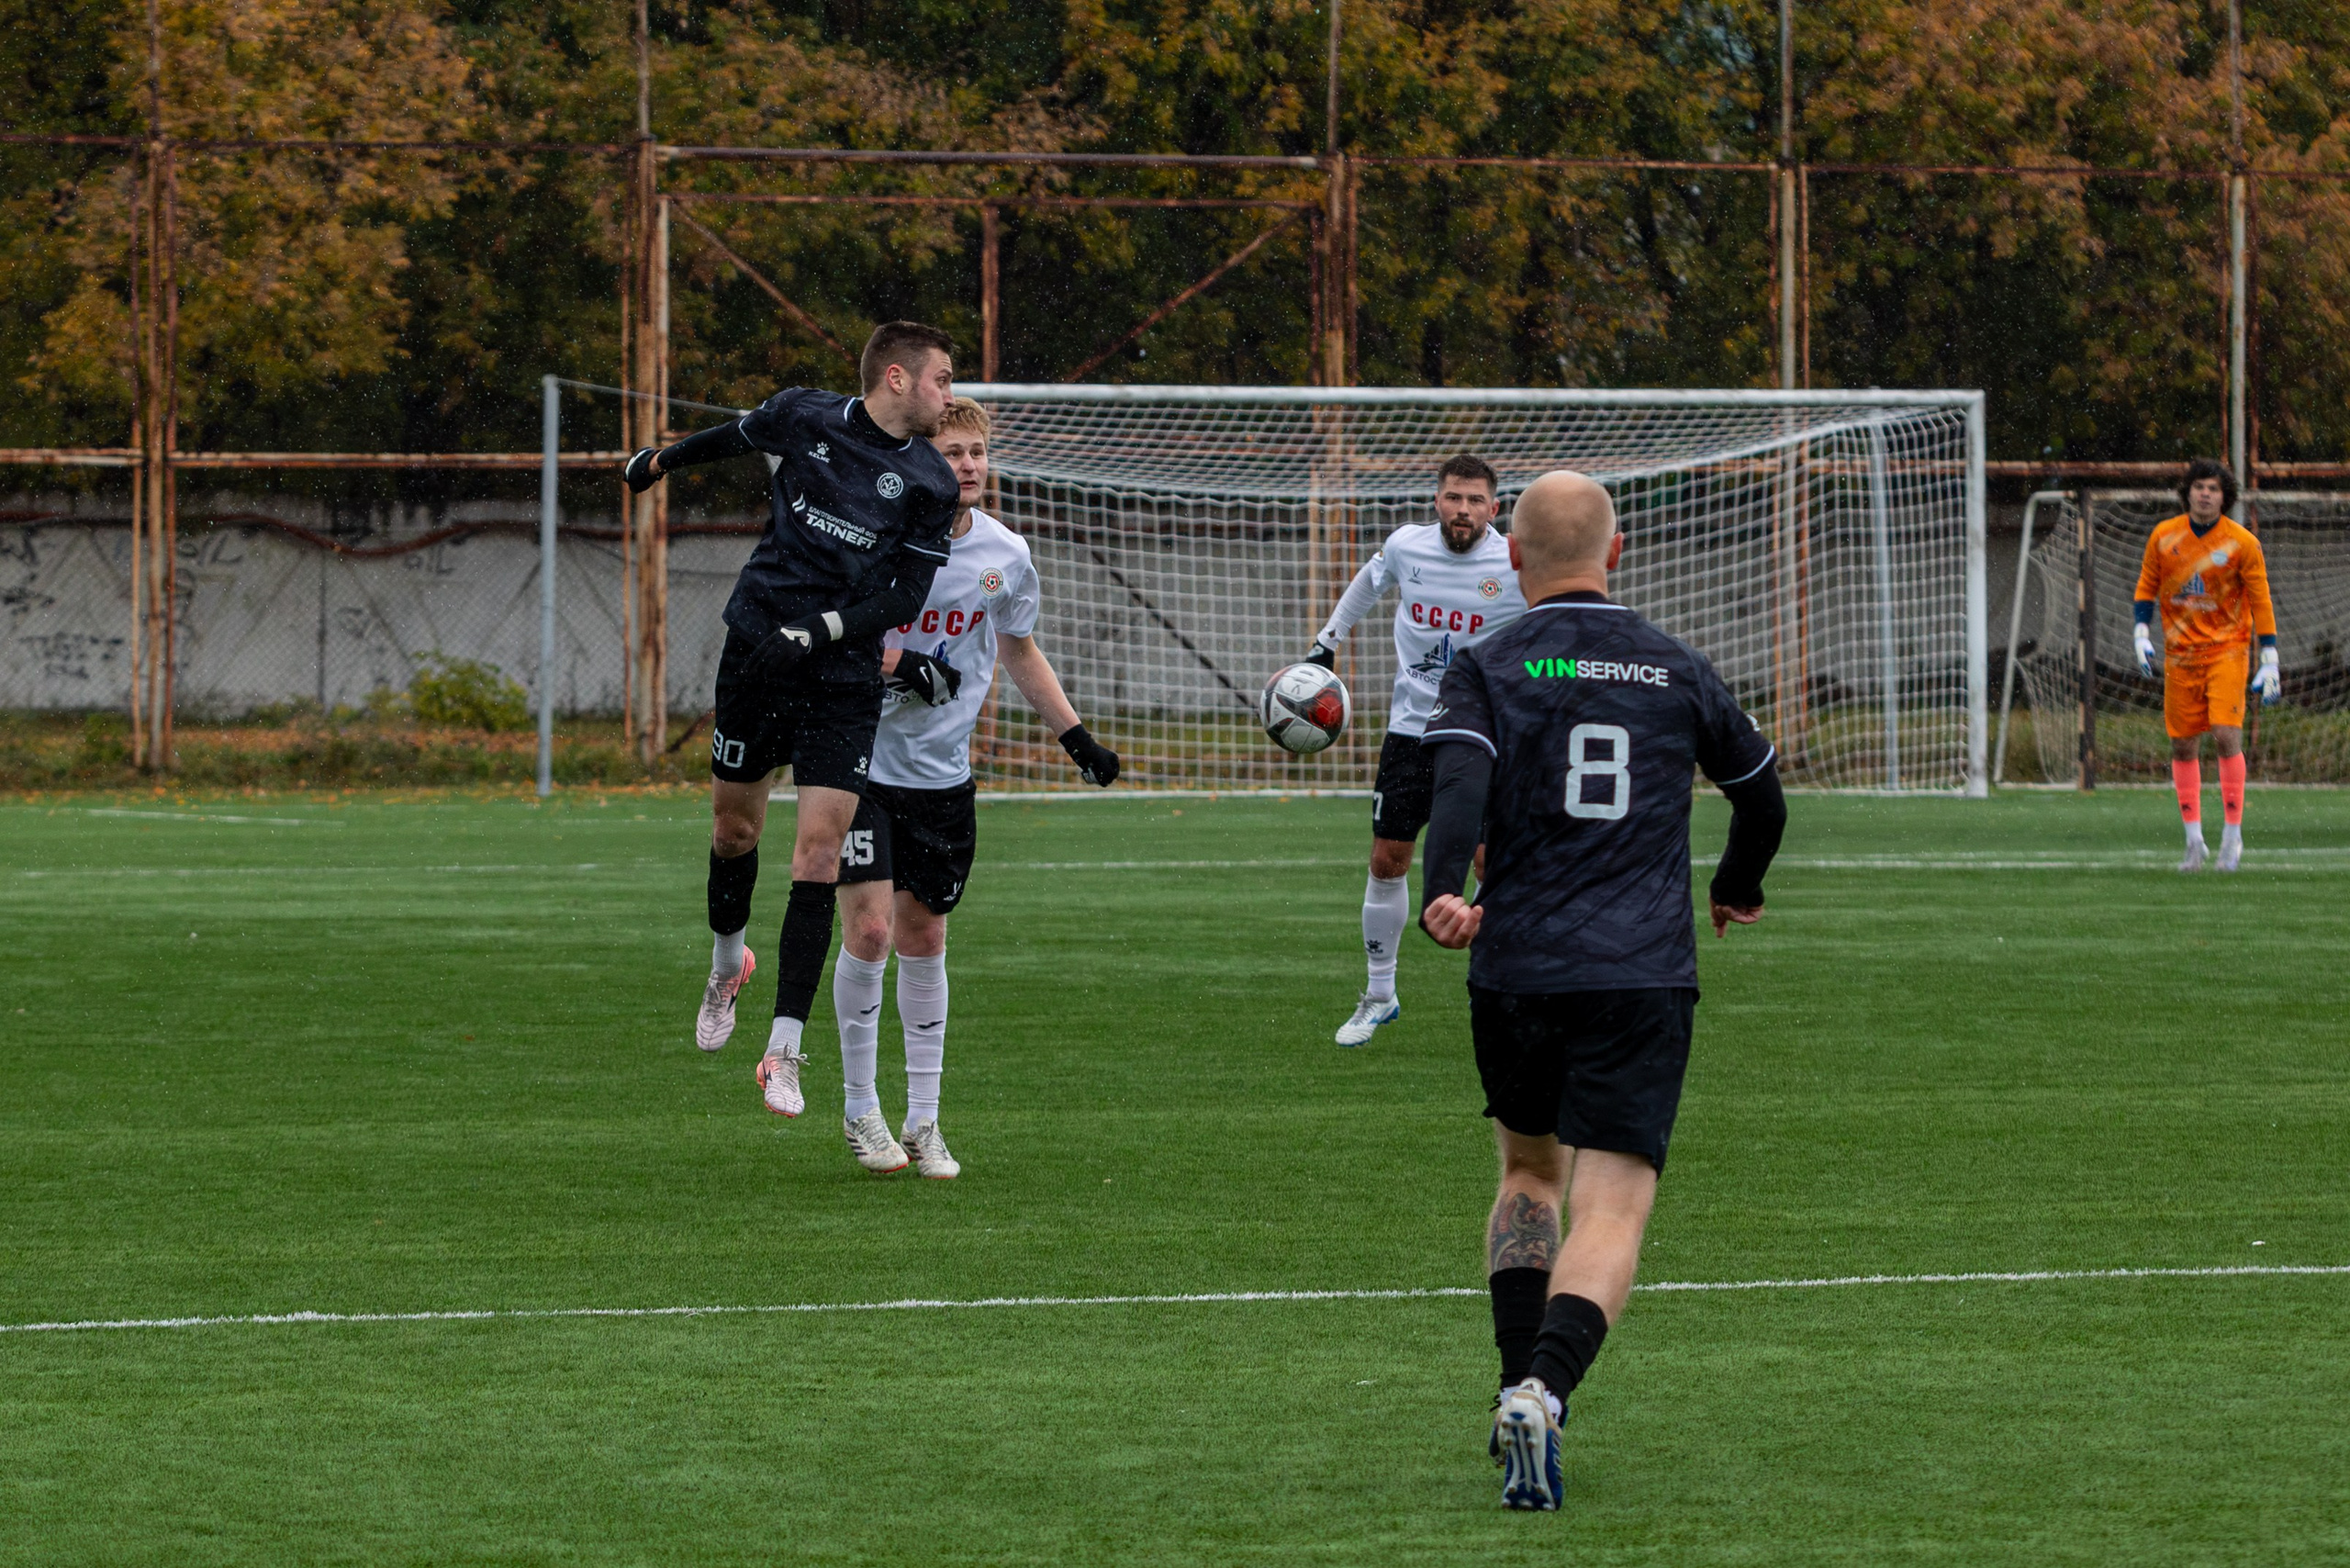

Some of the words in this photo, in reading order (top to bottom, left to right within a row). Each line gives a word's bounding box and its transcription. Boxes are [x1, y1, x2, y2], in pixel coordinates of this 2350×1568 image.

[808, 451, 831, 464] KELME
[806, 513, 877, 550] TATNEFT
[808, 506, 866, 535] БЛАГОТВОРИТЕЛЬНЫЙ
[1411, 602, 1483, 634] СССР
[1524, 657, 1669, 688] VINSERVICE
[712, 728, 745, 769] 90
[1563, 722, 1631, 821] 8
[840, 830, 874, 867] 45
